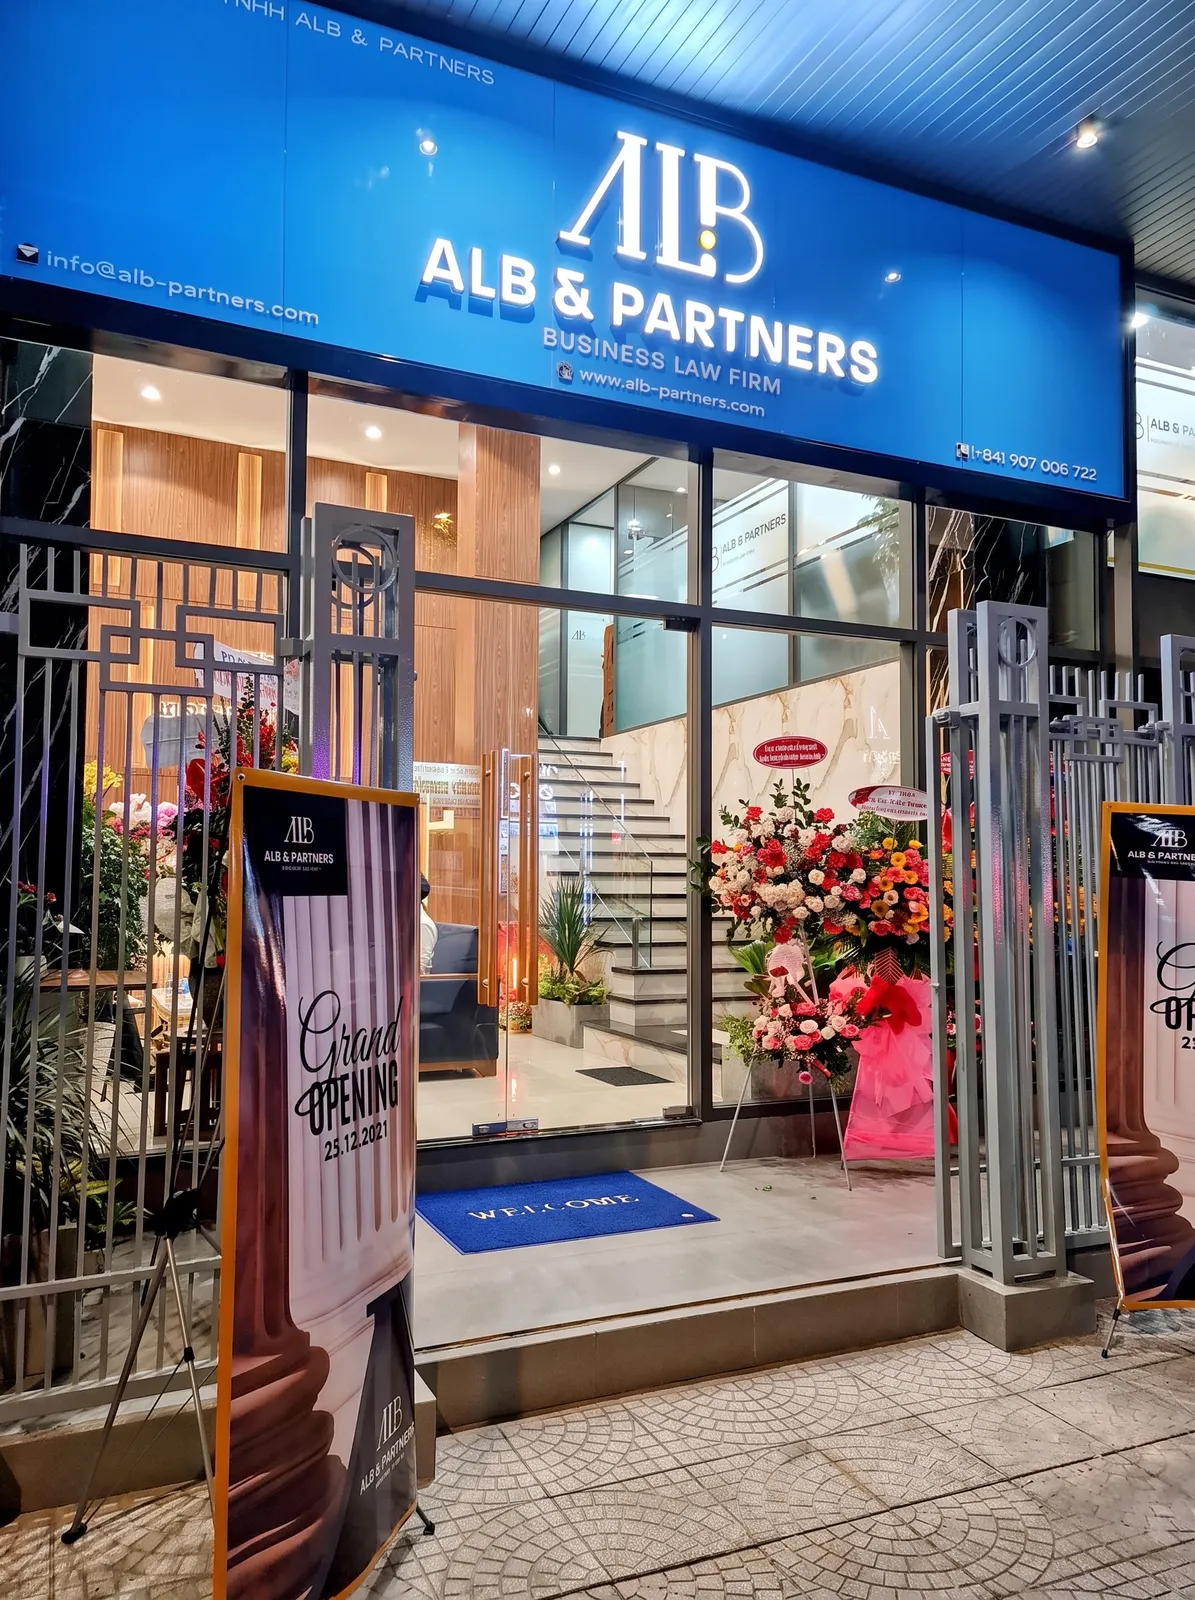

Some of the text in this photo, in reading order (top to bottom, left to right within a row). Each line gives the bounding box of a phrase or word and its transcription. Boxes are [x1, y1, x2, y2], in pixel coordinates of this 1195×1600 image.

[224, 0, 495, 85] NHH ALB & PARTNERS
[557, 130, 764, 283] ALB
[47, 250, 319, 325] info@alb-partners.com
[420, 237, 879, 385] ALB & PARTNERS
[543, 327, 781, 395] BUSINESS LAW FIRM
[579, 369, 765, 417] www.alb-partners.com
[1151, 418, 1170, 431] ALB
[1172, 423, 1179, 434] &
[1009, 453, 1036, 469] 907
[1040, 459, 1069, 475] 006
[1072, 465, 1097, 480] 722
[722, 513, 787, 554] ALB & PARTNERS
[264, 850, 334, 864] ALB & PARTNERS
[1127, 850, 1146, 858] ALB
[1147, 851, 1156, 859] &
[295, 990, 403, 1116] Grand
[309, 1059, 398, 1136] OPENING
[324, 1119, 388, 1161] 25.12.2021
[467, 1194, 641, 1220] WELCOME
[360, 1468, 375, 1496] ALB
